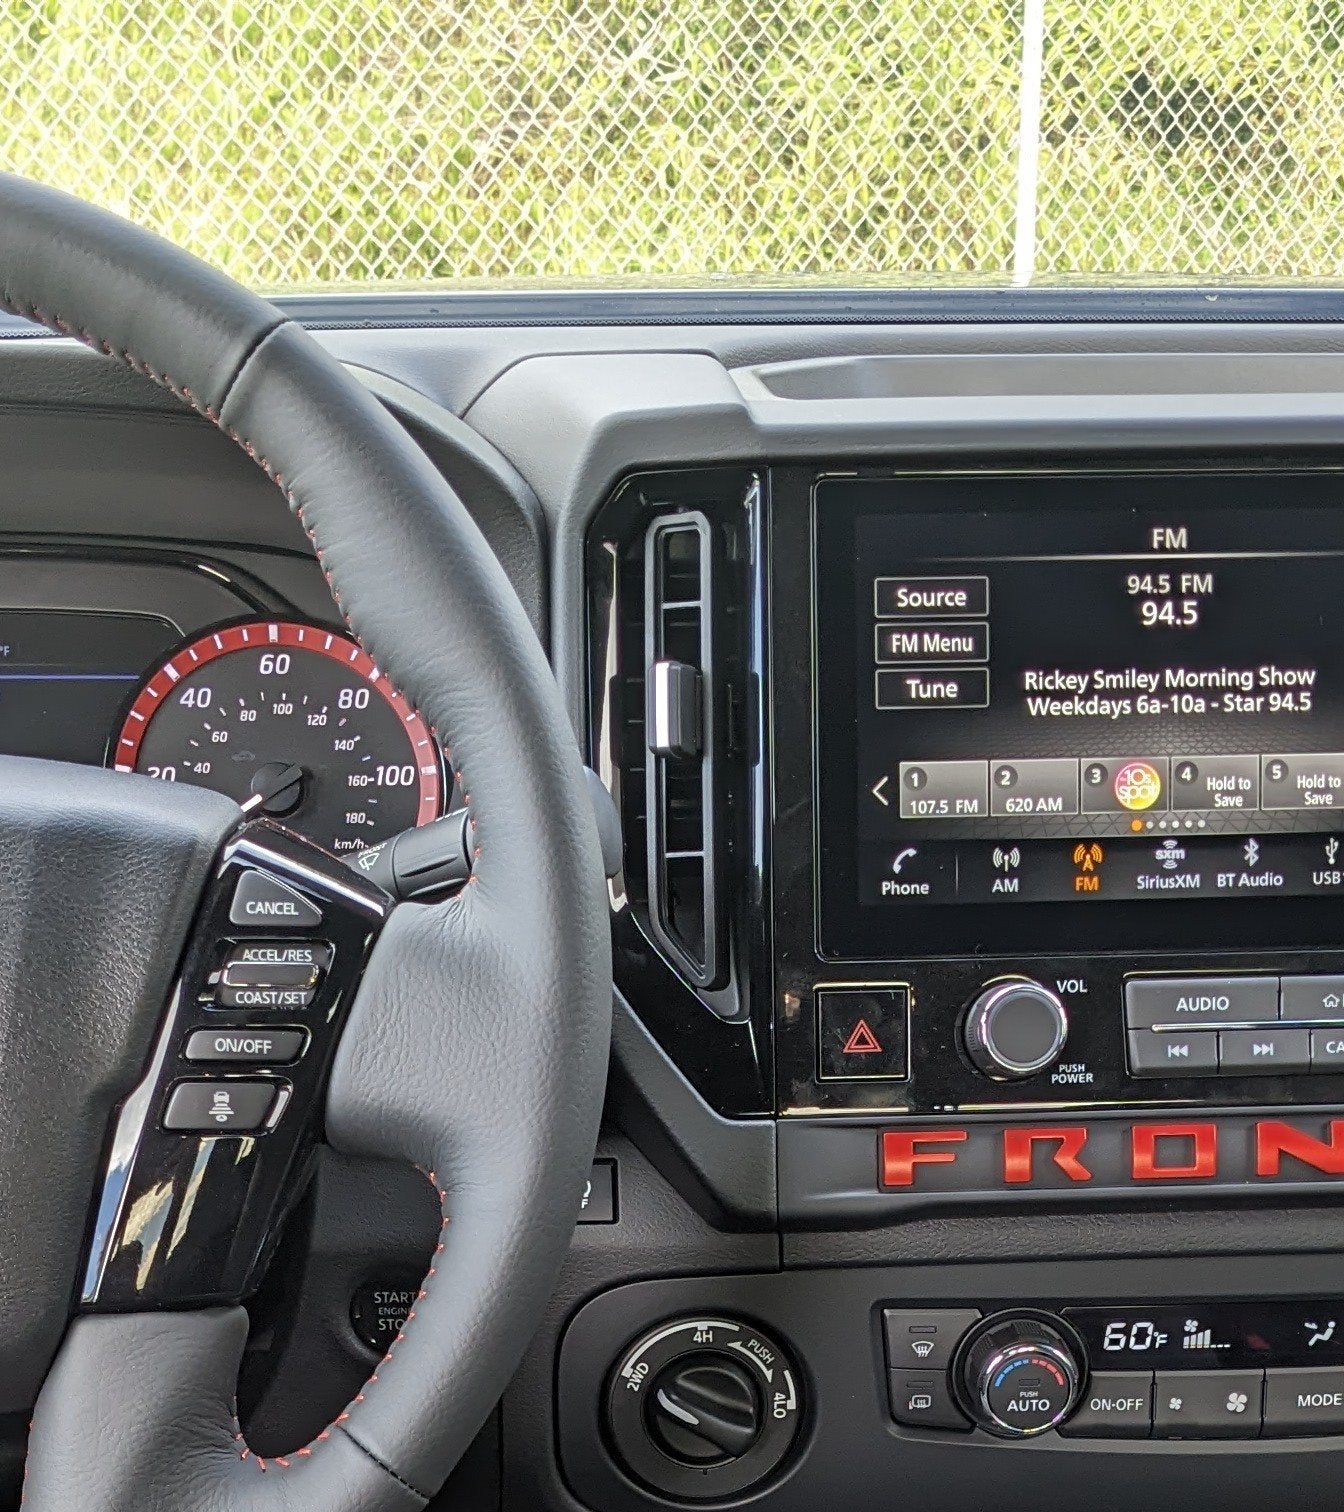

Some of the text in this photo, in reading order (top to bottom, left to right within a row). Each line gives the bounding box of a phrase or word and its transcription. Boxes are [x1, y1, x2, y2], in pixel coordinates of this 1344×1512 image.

[1152, 528, 1188, 549] FM
[1127, 574, 1213, 594] 94.5 FM
[897, 588, 967, 608] Source
[1142, 601, 1198, 626] 94.5
[891, 633, 974, 653] FM Menu
[259, 654, 291, 676] 60
[1025, 665, 1316, 694] Rickey Smiley Morning Show
[906, 679, 958, 699] Tune
[179, 687, 212, 708] 40
[338, 688, 370, 710] 80
[272, 703, 293, 715] 100
[1027, 695, 1132, 719] Weekdays
[1136, 695, 1206, 714] 6a-10a
[1223, 694, 1265, 713] Star
[1269, 692, 1312, 712] 94.5
[240, 710, 256, 722] 80
[307, 714, 328, 727] 120
[212, 731, 228, 743] 60
[334, 739, 355, 752] 140
[194, 762, 211, 775] 40
[376, 765, 415, 787] 100
[1181, 767, 1191, 781] 4
[1272, 766, 1282, 780] 5
[348, 775, 368, 787] 160
[911, 772, 919, 787] 1
[1001, 771, 1011, 786] 2
[1091, 769, 1101, 784] 3
[1206, 776, 1251, 791] Hold to
[1297, 775, 1341, 789] Hold to
[910, 799, 979, 814] 107.5 FM
[1005, 797, 1063, 812] 620 AM
[1214, 793, 1243, 808] Save
[1304, 792, 1333, 806] Save
[345, 812, 366, 825] 180
[334, 838, 364, 850] km/h
[992, 876, 1019, 893] AM
[1075, 875, 1099, 892] FM
[1136, 872, 1201, 889] SiriusXM
[1217, 872, 1284, 888] BT Audio
[881, 880, 931, 898] Phone
[246, 901, 299, 917] CANCEL
[242, 949, 313, 962] ACCEL/RES
[1056, 979, 1087, 994] VOL
[235, 992, 307, 1005] COAST/SET
[1176, 996, 1230, 1012] AUDIO
[214, 1038, 272, 1055] ON/OFF
[1058, 1063, 1086, 1074] PUSH
[1051, 1072, 1094, 1085] POWER
[374, 1292, 416, 1304] START
[378, 1307, 408, 1315] ENGIN
[378, 1318, 405, 1331] STO
[693, 1330, 713, 1343] 4H
[747, 1338, 776, 1365] PUSH
[626, 1362, 649, 1392] 2WD
[773, 1391, 787, 1419] 4LO
[1006, 1398, 1050, 1412] AUTO
[1297, 1393, 1343, 1408] MODE
